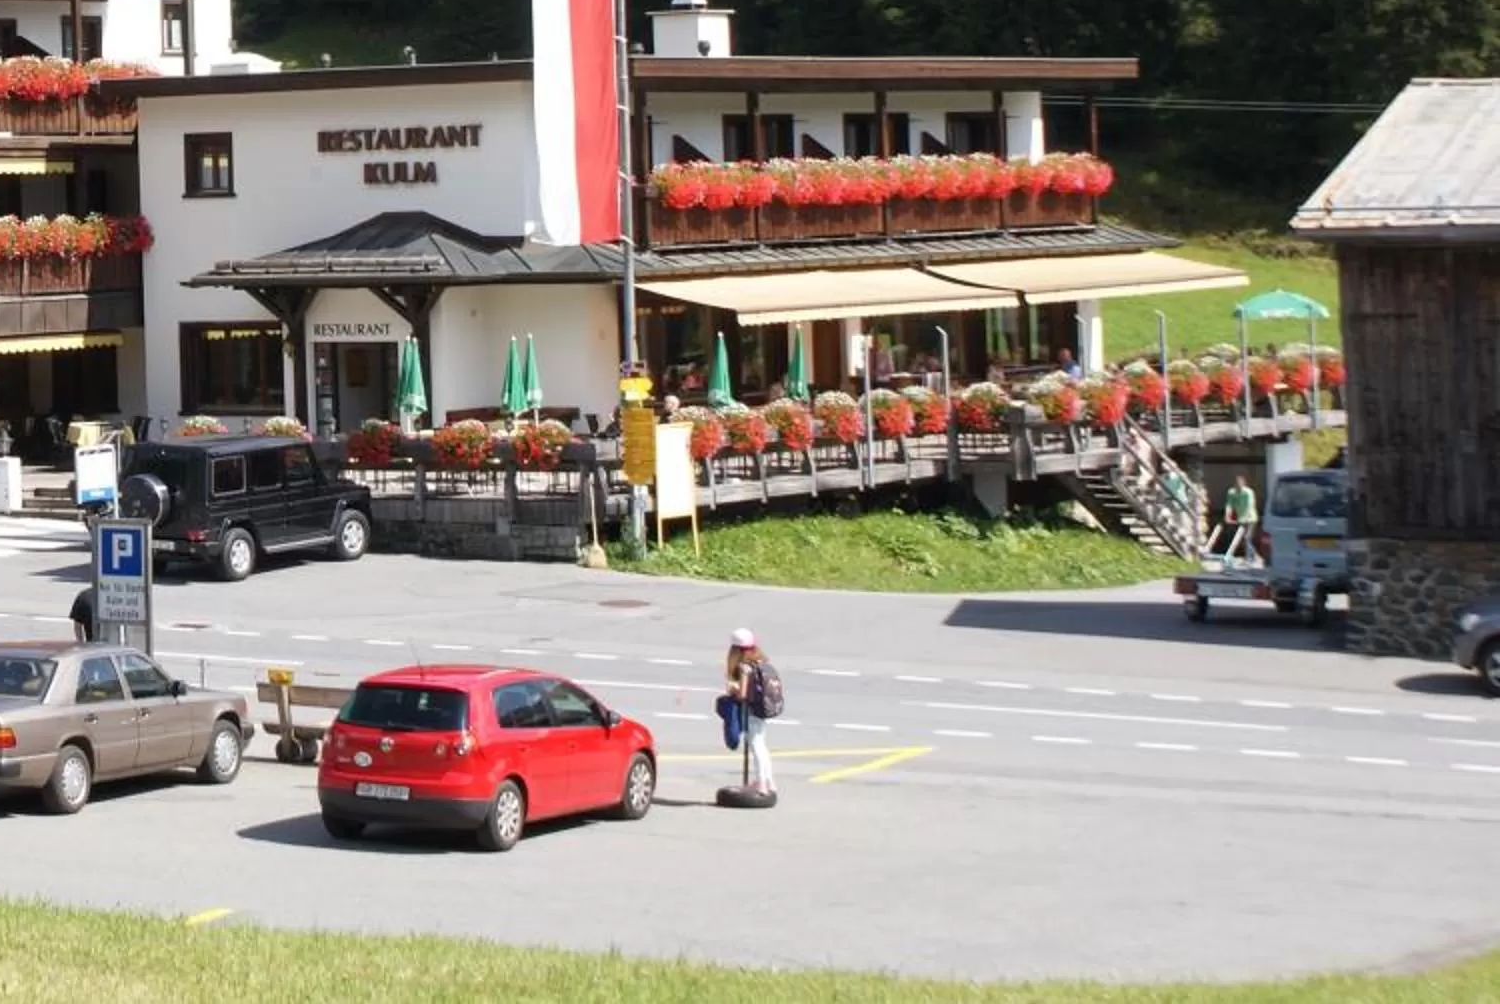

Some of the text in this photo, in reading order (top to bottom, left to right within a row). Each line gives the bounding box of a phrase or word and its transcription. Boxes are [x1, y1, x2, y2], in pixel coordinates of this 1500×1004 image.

[317, 123, 482, 152] RESTAURANT
[364, 162, 438, 184] KULM
[313, 323, 390, 336] RESTAURANT
